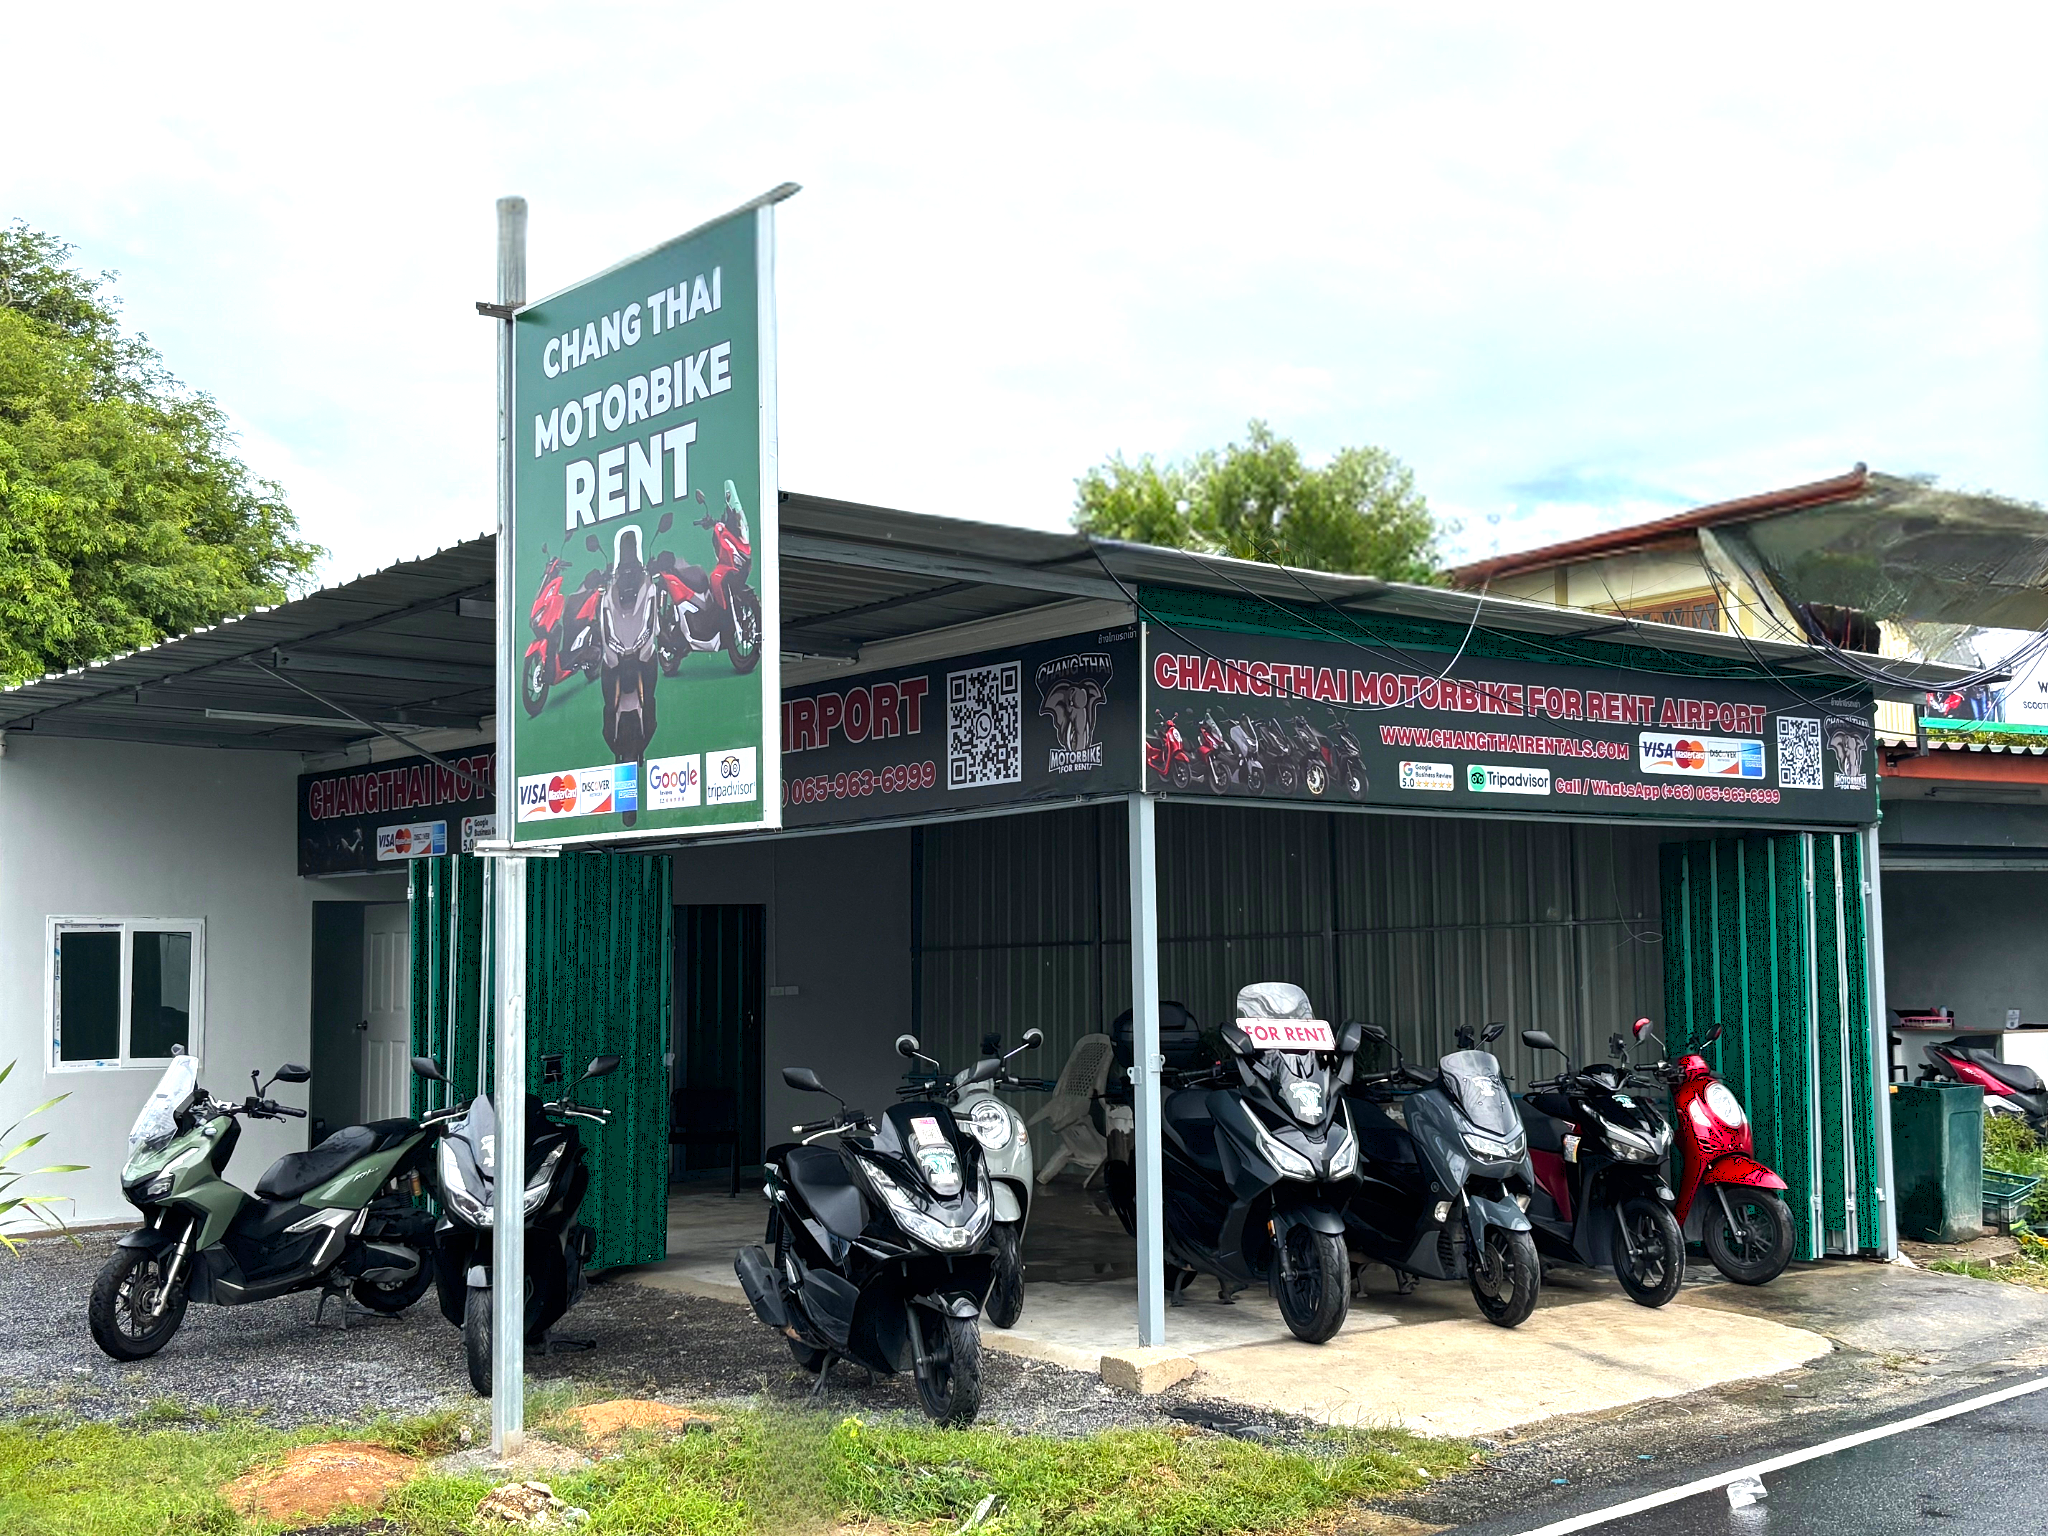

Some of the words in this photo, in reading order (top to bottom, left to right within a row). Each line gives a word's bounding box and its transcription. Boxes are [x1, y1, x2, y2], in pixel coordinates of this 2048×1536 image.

[543, 302, 642, 379] CHANG
[647, 266, 722, 335] THAI
[535, 341, 732, 458] MOTORBIKE
[565, 421, 698, 531] RENT
[1154, 652, 1347, 703] CHANGTHAI
[1352, 670, 1523, 717] MOTORBIKE
[1527, 685, 1582, 721] FOR
[1586, 690, 1655, 726] RENT
[1659, 697, 1766, 734] AIRPORT
[2022, 701, 2048, 710] SCOOT
[781, 675, 929, 754] IRPORT
[1379, 725, 1629, 760] WWW.CHANGTHAIRENTALS.COM
[1643, 741, 1673, 758] VISA
[1050, 745, 1101, 769] MOTORBIKE
[650, 762, 697, 793] Google
[791, 760, 936, 805] 065-963-6999
[1402, 778, 1414, 787] 5.0
[1487, 771, 1548, 788] Tripadvisor
[309, 764, 432, 820] CHANGTHAI
[520, 783, 547, 805] VISA
[707, 780, 753, 801] tripadvisor
[1555, 778, 1581, 794] Call
[1591, 780, 1659, 800] WhatsApp
[1661, 784, 1694, 801] (+66)
[1695, 785, 1780, 804] 065-963-6999
[379, 833, 395, 848] VISA
[463, 839, 474, 852] 5.0
[1245, 1026, 1281, 1041] FOR
[1284, 1026, 1327, 1042] RENT
